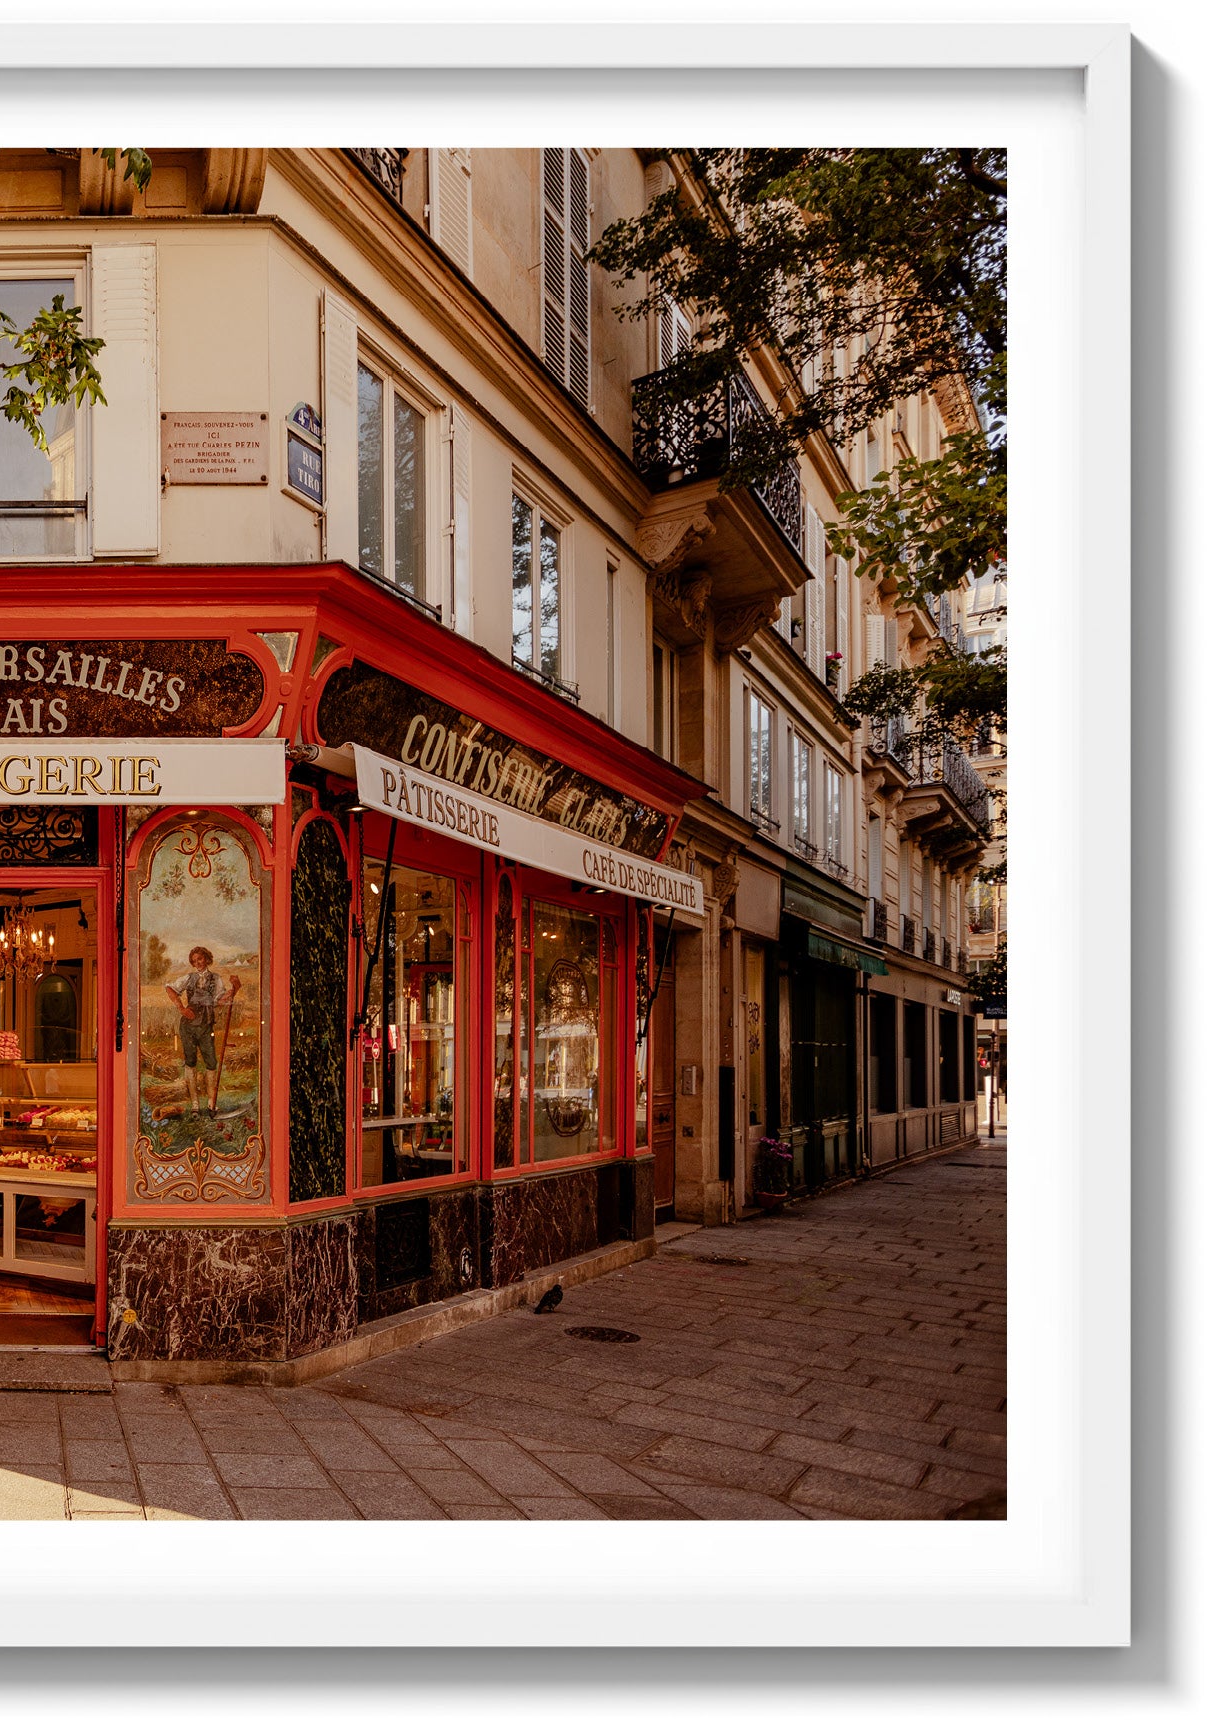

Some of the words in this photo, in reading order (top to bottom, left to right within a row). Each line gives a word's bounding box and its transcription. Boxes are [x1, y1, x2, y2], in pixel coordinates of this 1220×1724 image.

[298, 467, 320, 493] TIRO
[302, 450, 321, 475] RUE
[380, 767, 500, 847] PÂTISSERIE
[401, 714, 553, 817] CONFISERIE
[559, 788, 631, 847] GLACES
[583, 849, 616, 886] CAFÉ
[618, 861, 636, 892] DE
[636, 867, 696, 908] SPÉCIALITÉ
